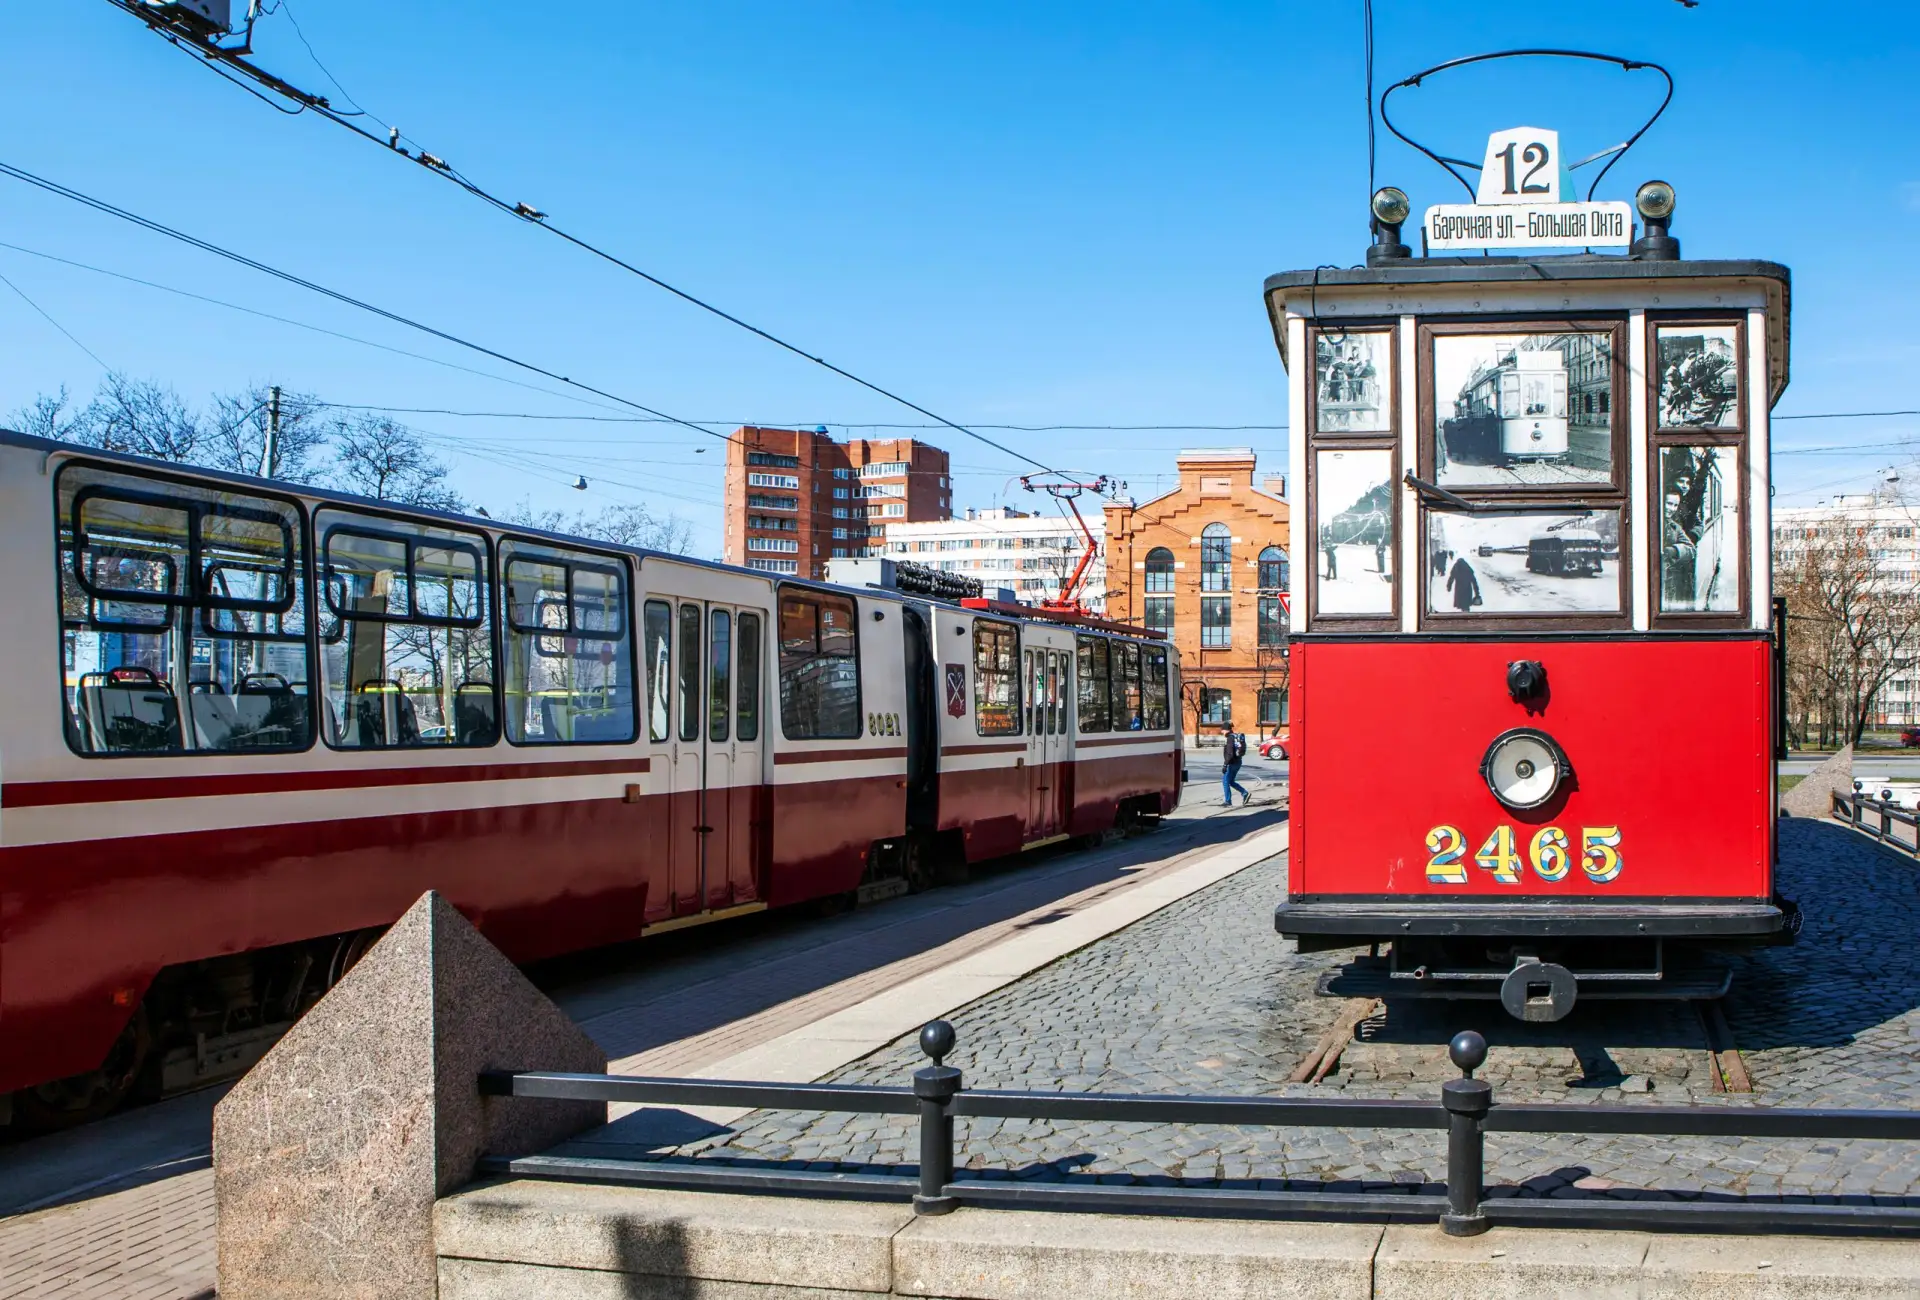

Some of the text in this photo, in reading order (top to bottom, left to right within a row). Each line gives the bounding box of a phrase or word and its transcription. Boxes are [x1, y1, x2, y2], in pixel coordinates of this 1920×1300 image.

[1495, 142, 1551, 195] 12
[1432, 214, 1493, 240] Барочная
[1528, 211, 1586, 238] Большая
[1591, 210, 1623, 237] Охта
[1425, 825, 1624, 885] 2465
